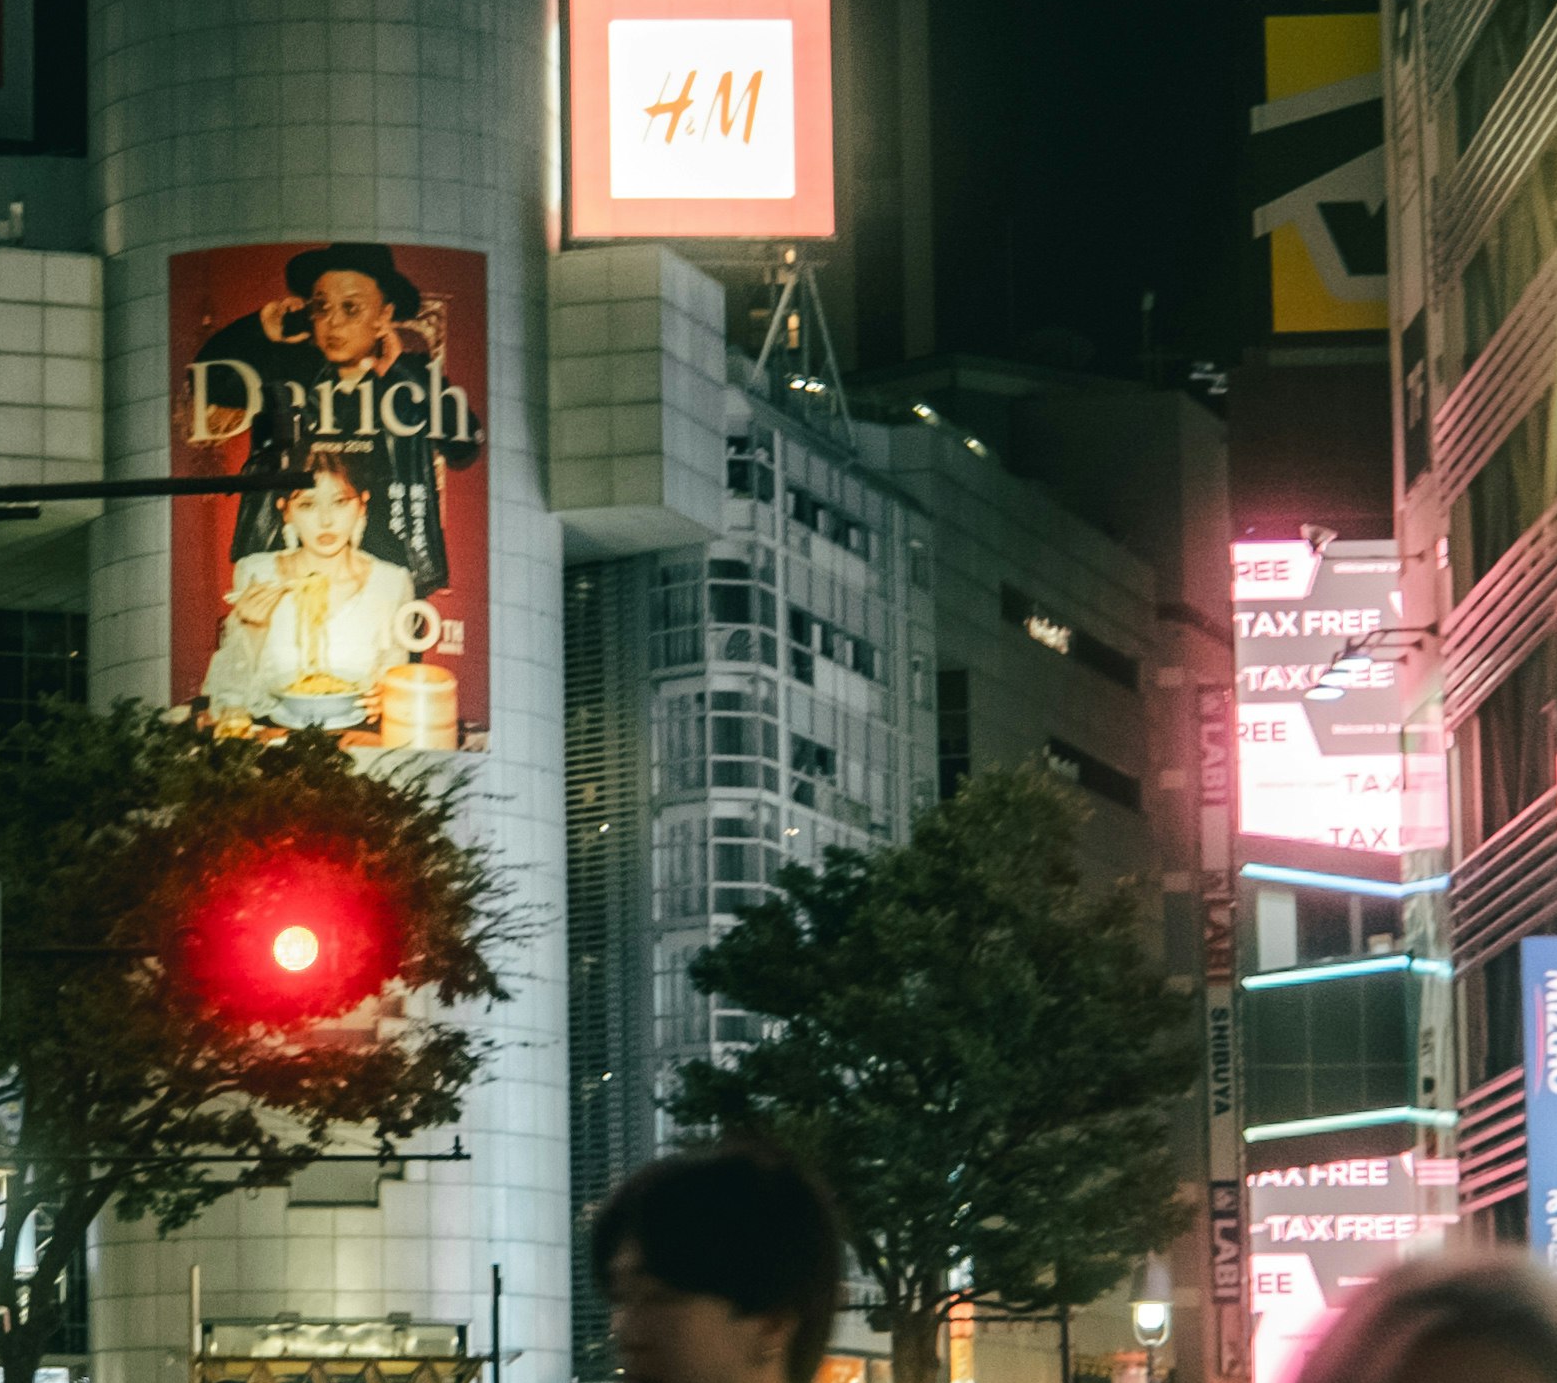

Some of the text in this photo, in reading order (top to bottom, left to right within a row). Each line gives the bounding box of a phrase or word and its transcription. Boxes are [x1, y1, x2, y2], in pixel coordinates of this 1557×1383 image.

[643, 69, 764, 145] H&M
[1234, 611, 1298, 638] TAX
[1242, 663, 1311, 691] TAX
[1212, 1006, 1232, 1115] SHIBUYA
[1309, 1159, 1389, 1187] FREE
[1265, 1214, 1418, 1242] TAX FREE
[1212, 1218, 1238, 1303] LABI
